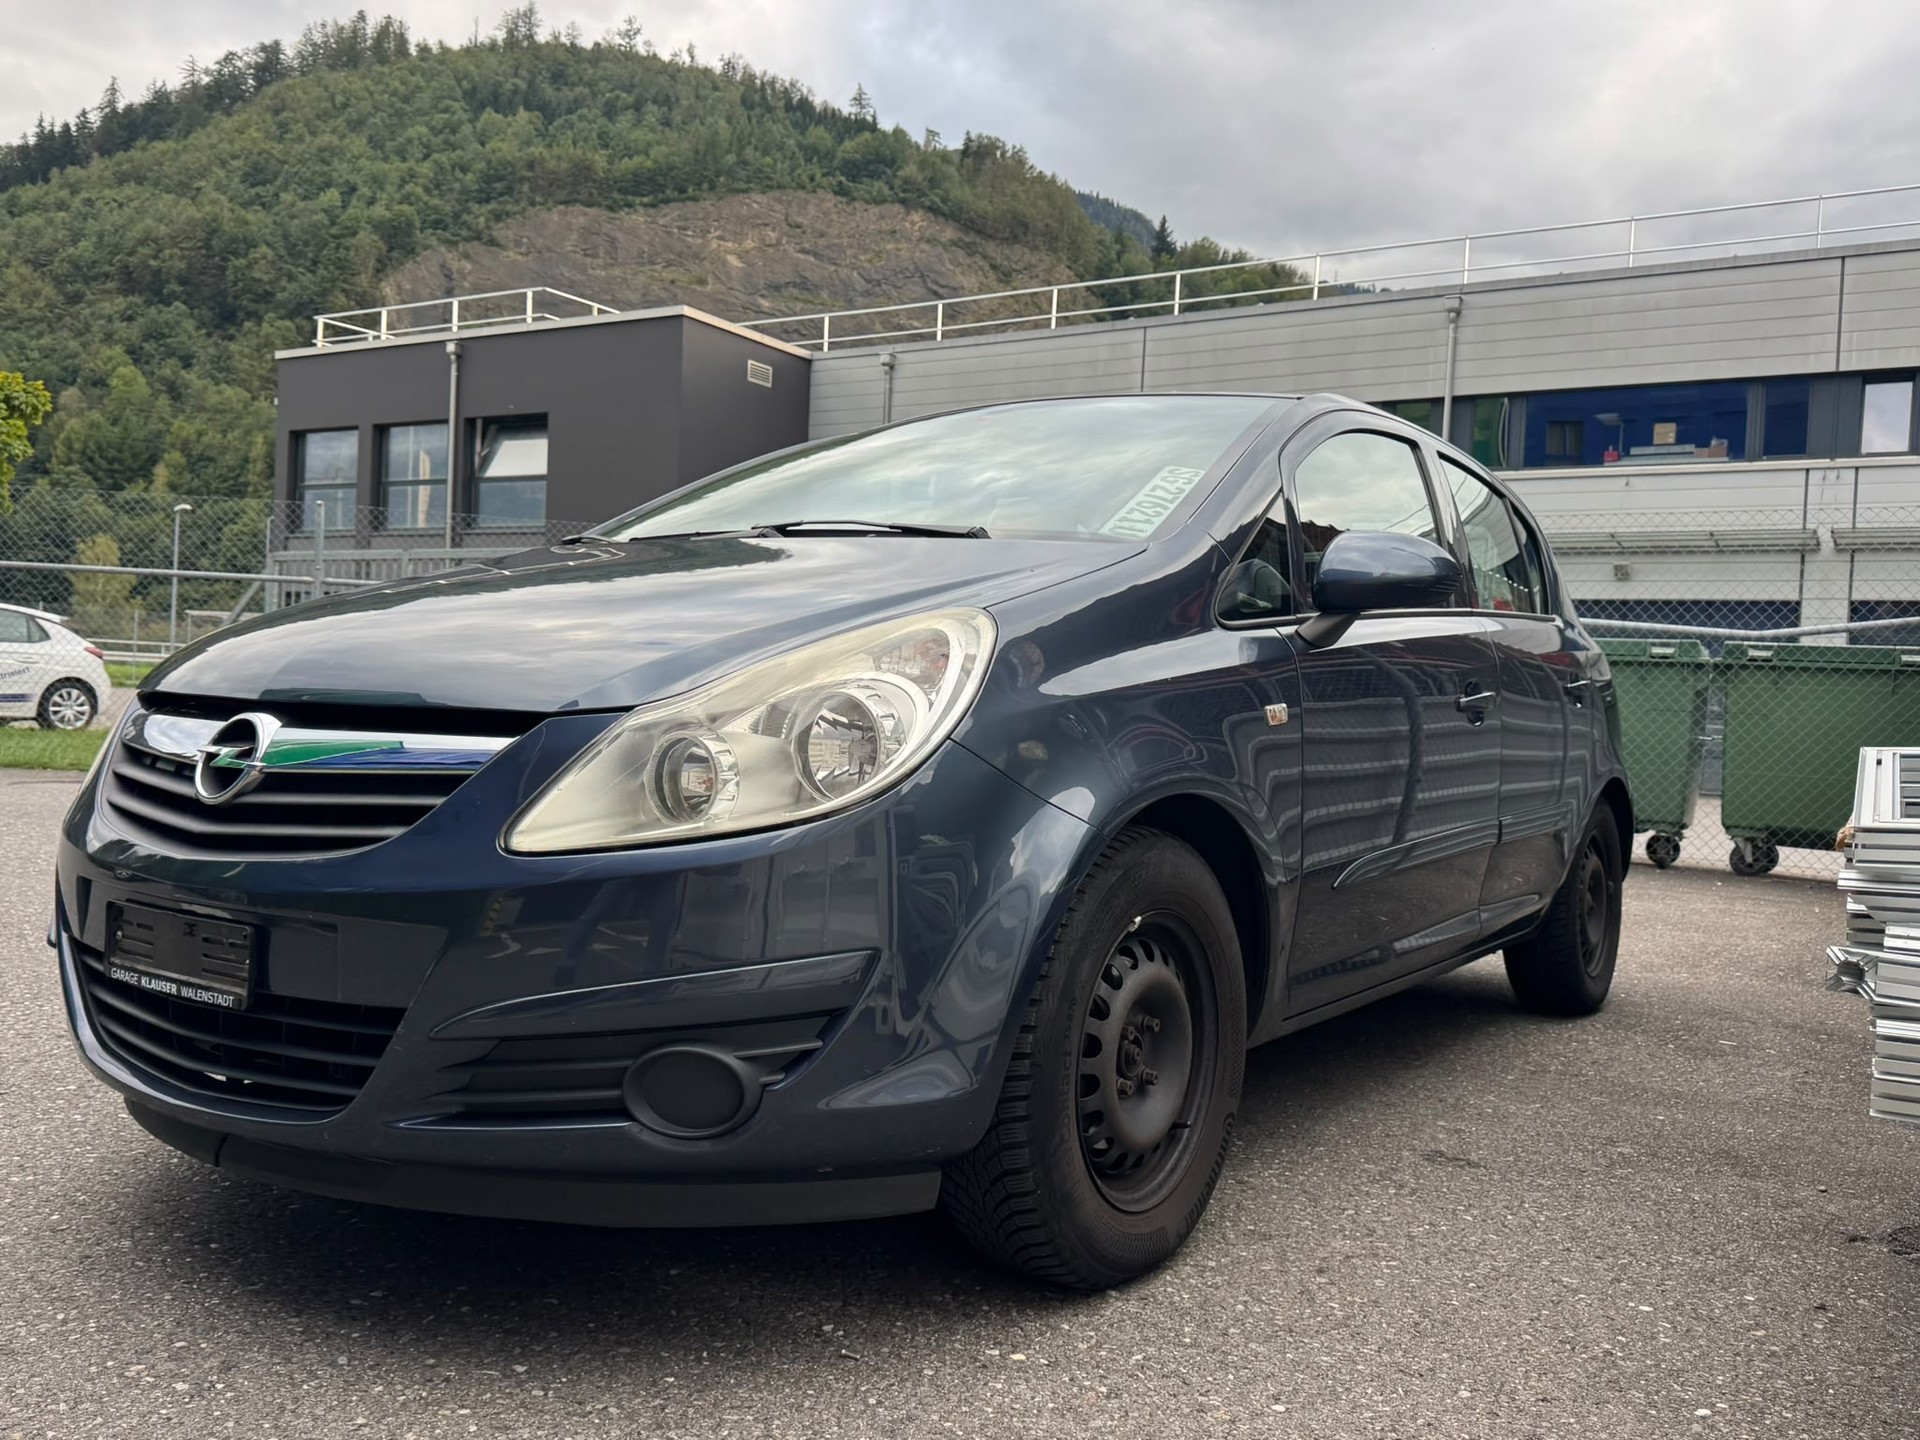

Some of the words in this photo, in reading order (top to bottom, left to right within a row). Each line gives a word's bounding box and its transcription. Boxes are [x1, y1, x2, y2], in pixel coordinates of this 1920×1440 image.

[110, 967, 139, 985] GARAGE
[140, 975, 177, 995] KLAUSER
[180, 985, 235, 1008] WALENSTADT
